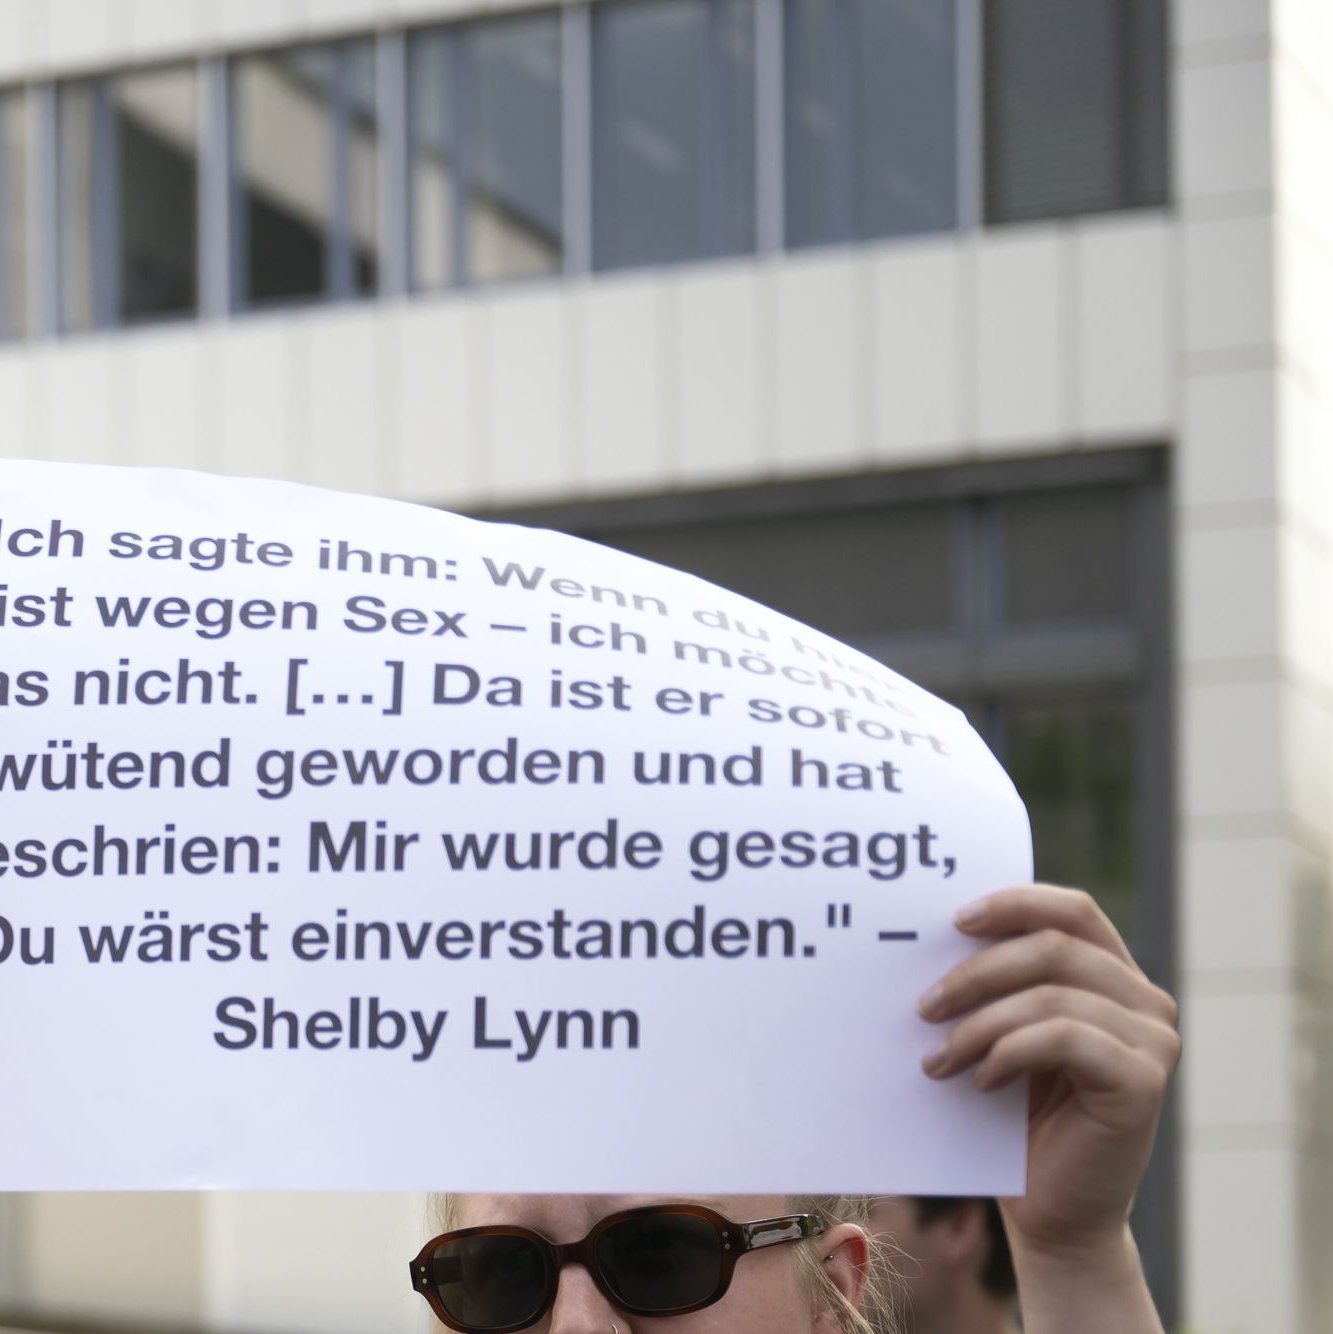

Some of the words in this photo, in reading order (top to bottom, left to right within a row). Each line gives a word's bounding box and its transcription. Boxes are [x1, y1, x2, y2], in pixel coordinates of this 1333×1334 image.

[108, 532, 294, 572] sagte
[318, 538, 457, 582] ihm:
[481, 557, 668, 619] Wenn
[693, 610, 771, 642] du
[94, 596, 318, 640] wegen
[342, 595, 469, 639] Sex
[550, 613, 647, 655] ich
[674, 639, 919, 719] möchte
[73, 657, 258, 706] nicht.
[432, 662, 523, 707] Da
[550, 668, 632, 712] ist
[654, 687, 725, 717] er
[748, 698, 951, 757] sofort
[255, 736, 606, 801] geworden
[632, 744, 763, 787] und
[790, 747, 903, 794] hat
[308, 819, 420, 873] Mir
[440, 817, 664, 872] wurde
[688, 823, 957, 883] gesagt,
[78, 910, 270, 964] wärst
[291, 902, 852, 962] einverstanden."
[213, 995, 449, 1063] Shelby
[472, 995, 640, 1064] Lynn
